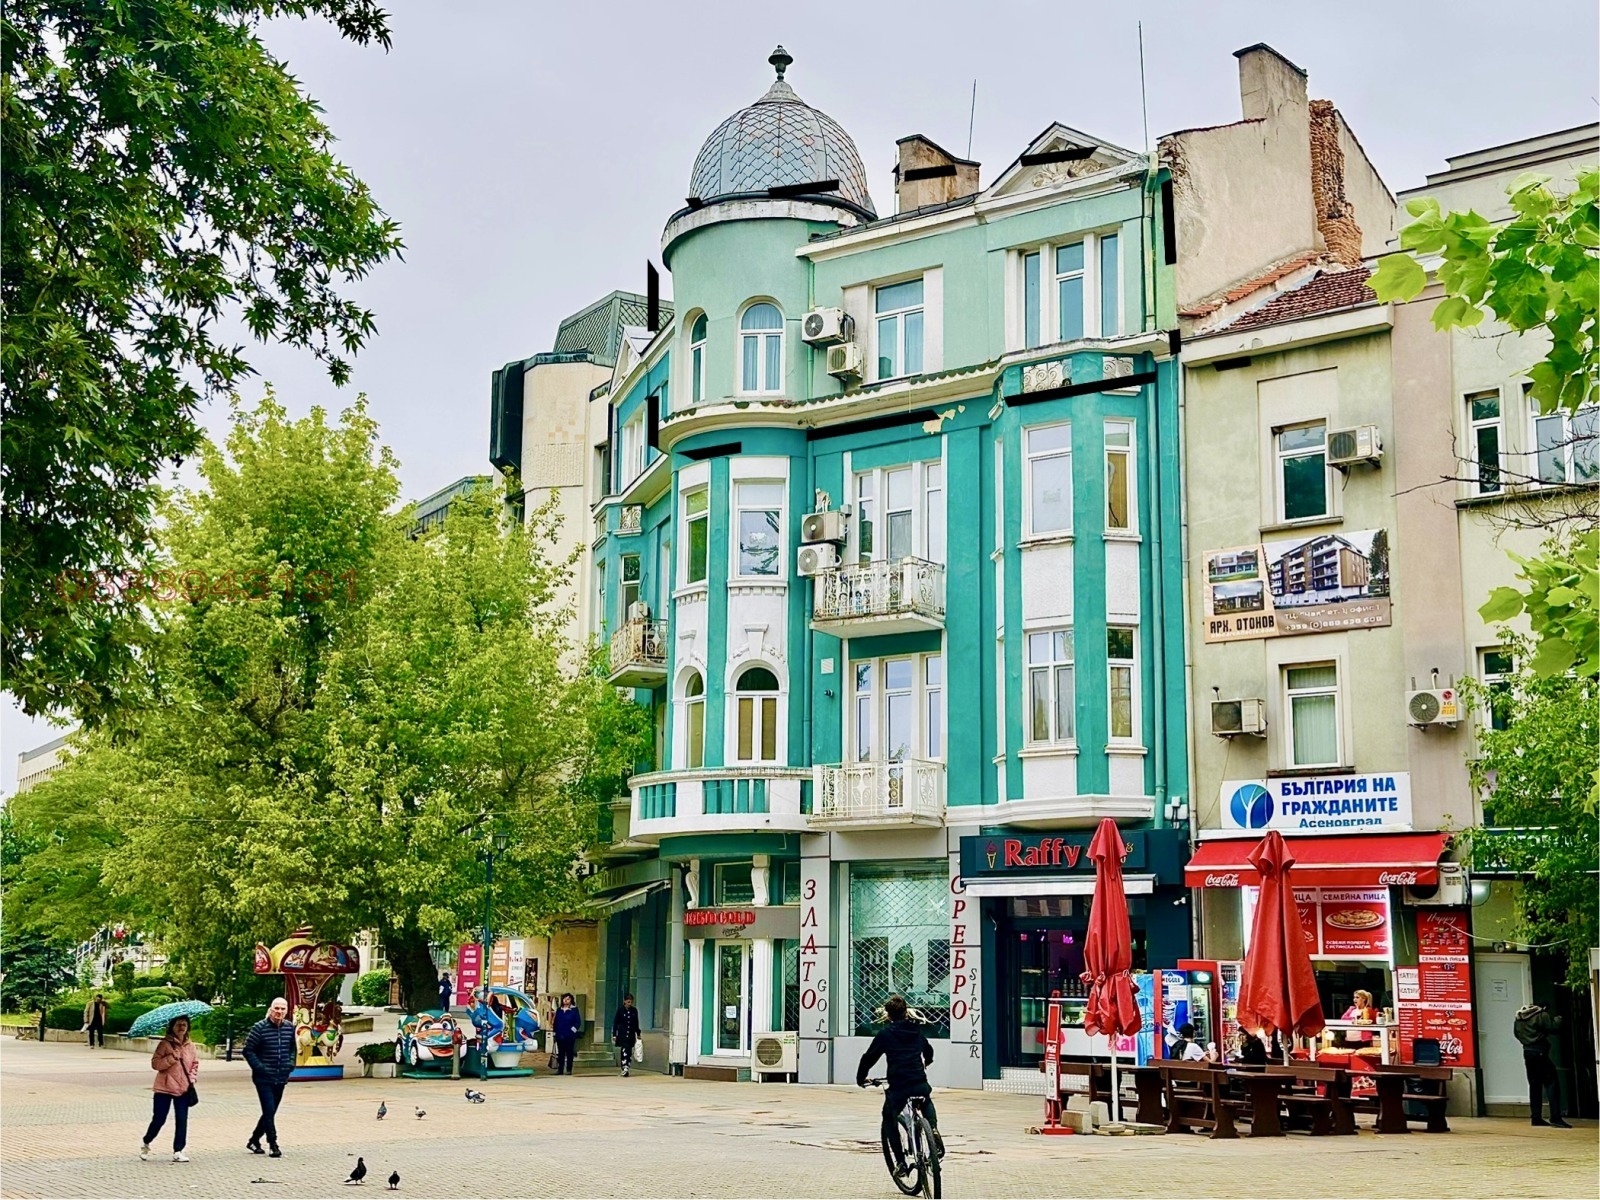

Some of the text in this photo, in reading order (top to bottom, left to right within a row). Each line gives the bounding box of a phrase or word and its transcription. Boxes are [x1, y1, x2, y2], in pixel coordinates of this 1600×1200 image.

[1210, 619, 1232, 634] АРХ.
[1236, 615, 1275, 631] ОТОНОВ
[1281, 777, 1396, 796] БЪЛГАРИЯ НА
[1282, 797, 1398, 816] ГРАЖДАНИТЕ
[1299, 817, 1382, 829] Асеновград
[1004, 837, 1081, 868] Raffy
[1323, 892, 1387, 902] СЕМЕЙНА ПИЦА
[801, 878, 818, 1010] ЗЛАТО
[950, 875, 967, 1020] СРЕБРО
[816, 979, 827, 1054] GOLD
[969, 968, 980, 1059] SILVER
